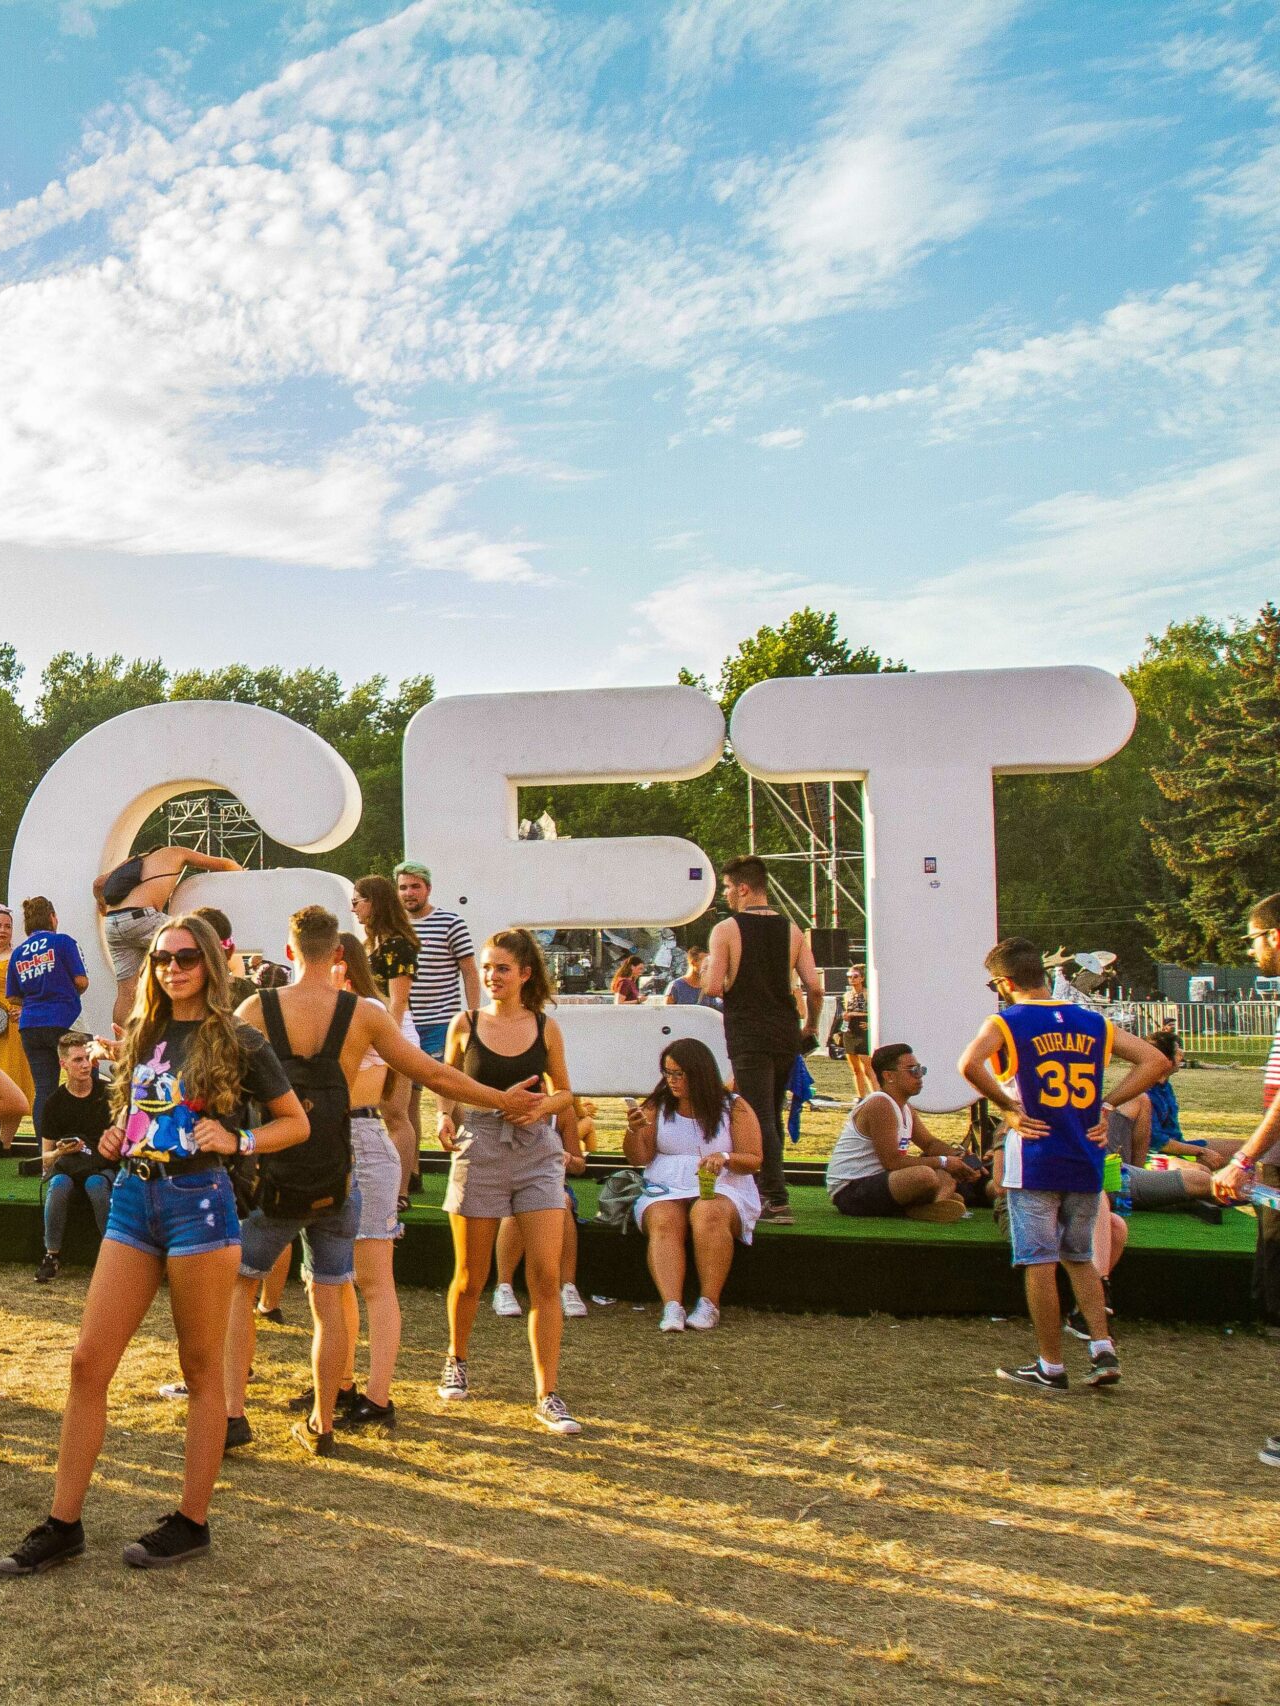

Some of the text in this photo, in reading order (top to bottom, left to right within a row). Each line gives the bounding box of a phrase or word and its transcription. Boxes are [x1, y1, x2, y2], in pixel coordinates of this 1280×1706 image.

[22, 938, 48, 956] 202
[21, 962, 55, 983] STAFF
[1031, 1032, 1097, 1057] DURANT
[1035, 1060, 1096, 1109] 35
